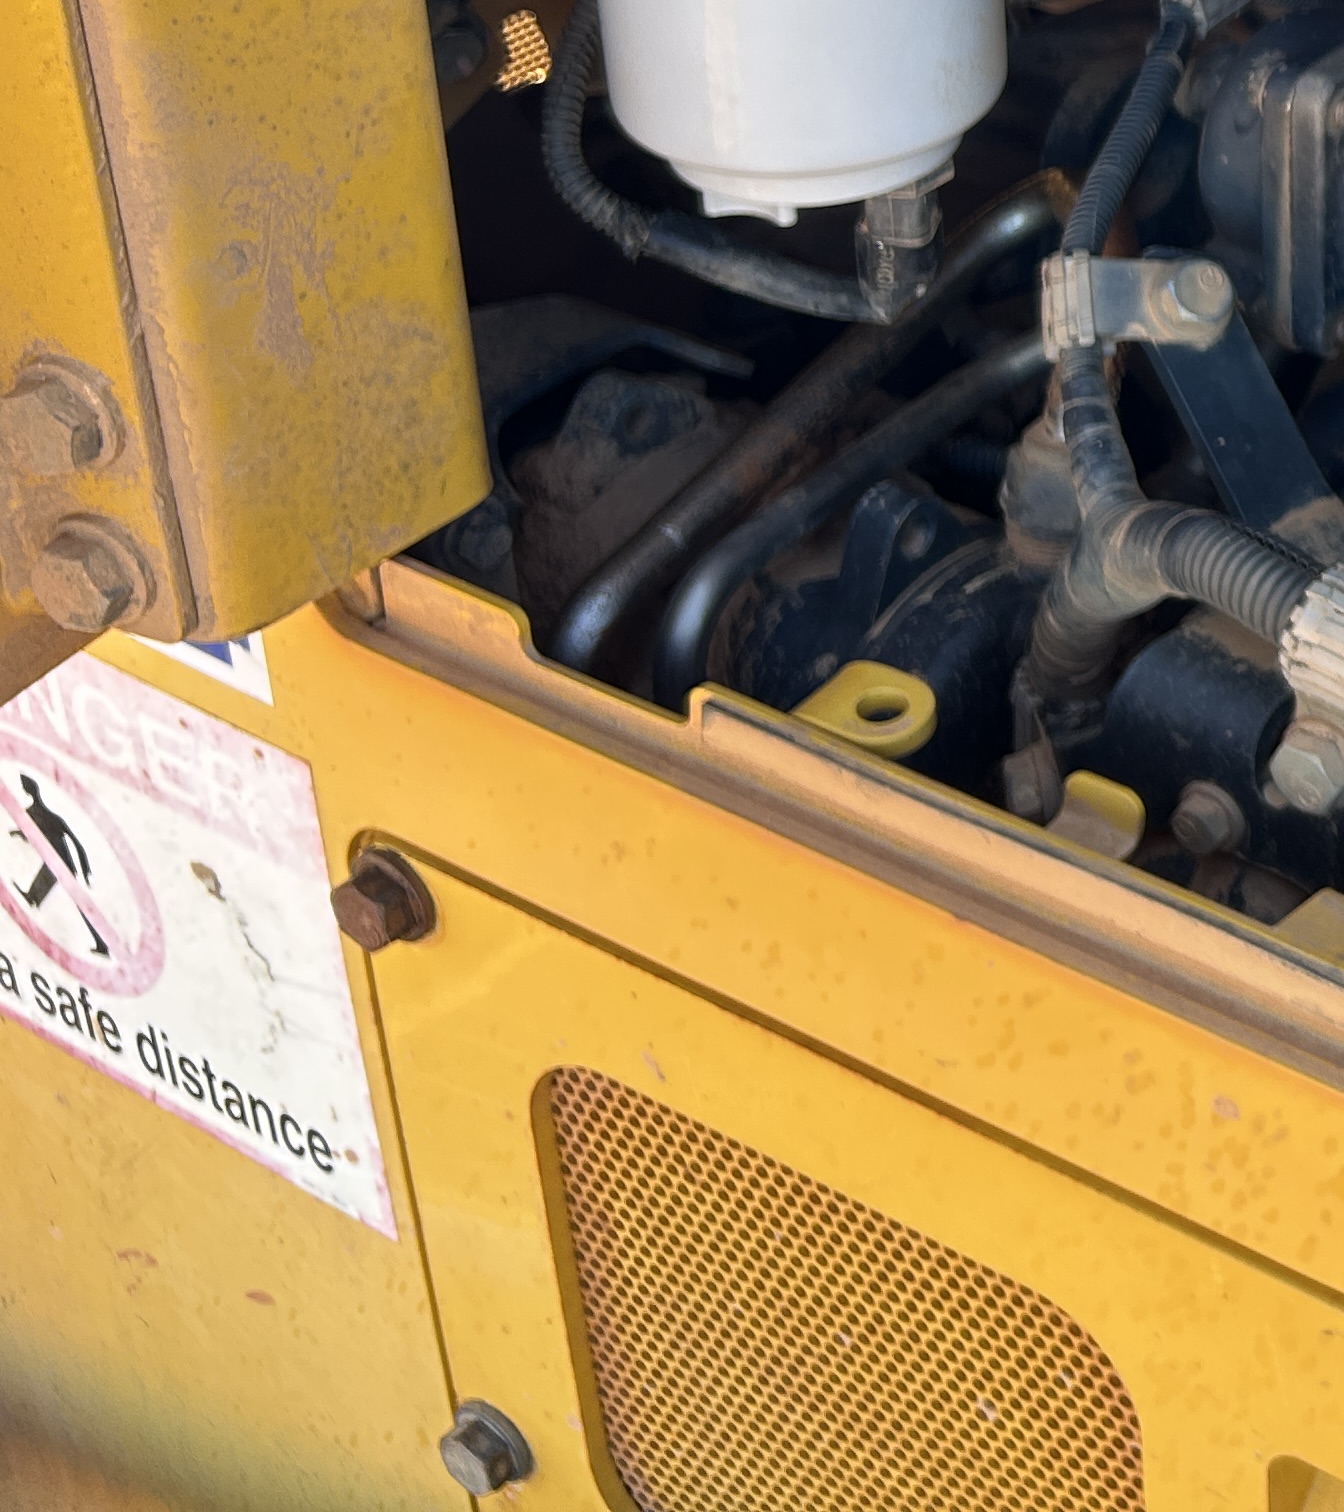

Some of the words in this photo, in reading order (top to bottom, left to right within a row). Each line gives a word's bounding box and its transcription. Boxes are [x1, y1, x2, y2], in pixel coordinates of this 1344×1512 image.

[0, 672, 263, 838] NGER
[0, 952, 20, 996] a
[30, 971, 122, 1055] safe
[137, 1022, 333, 1172] distance
